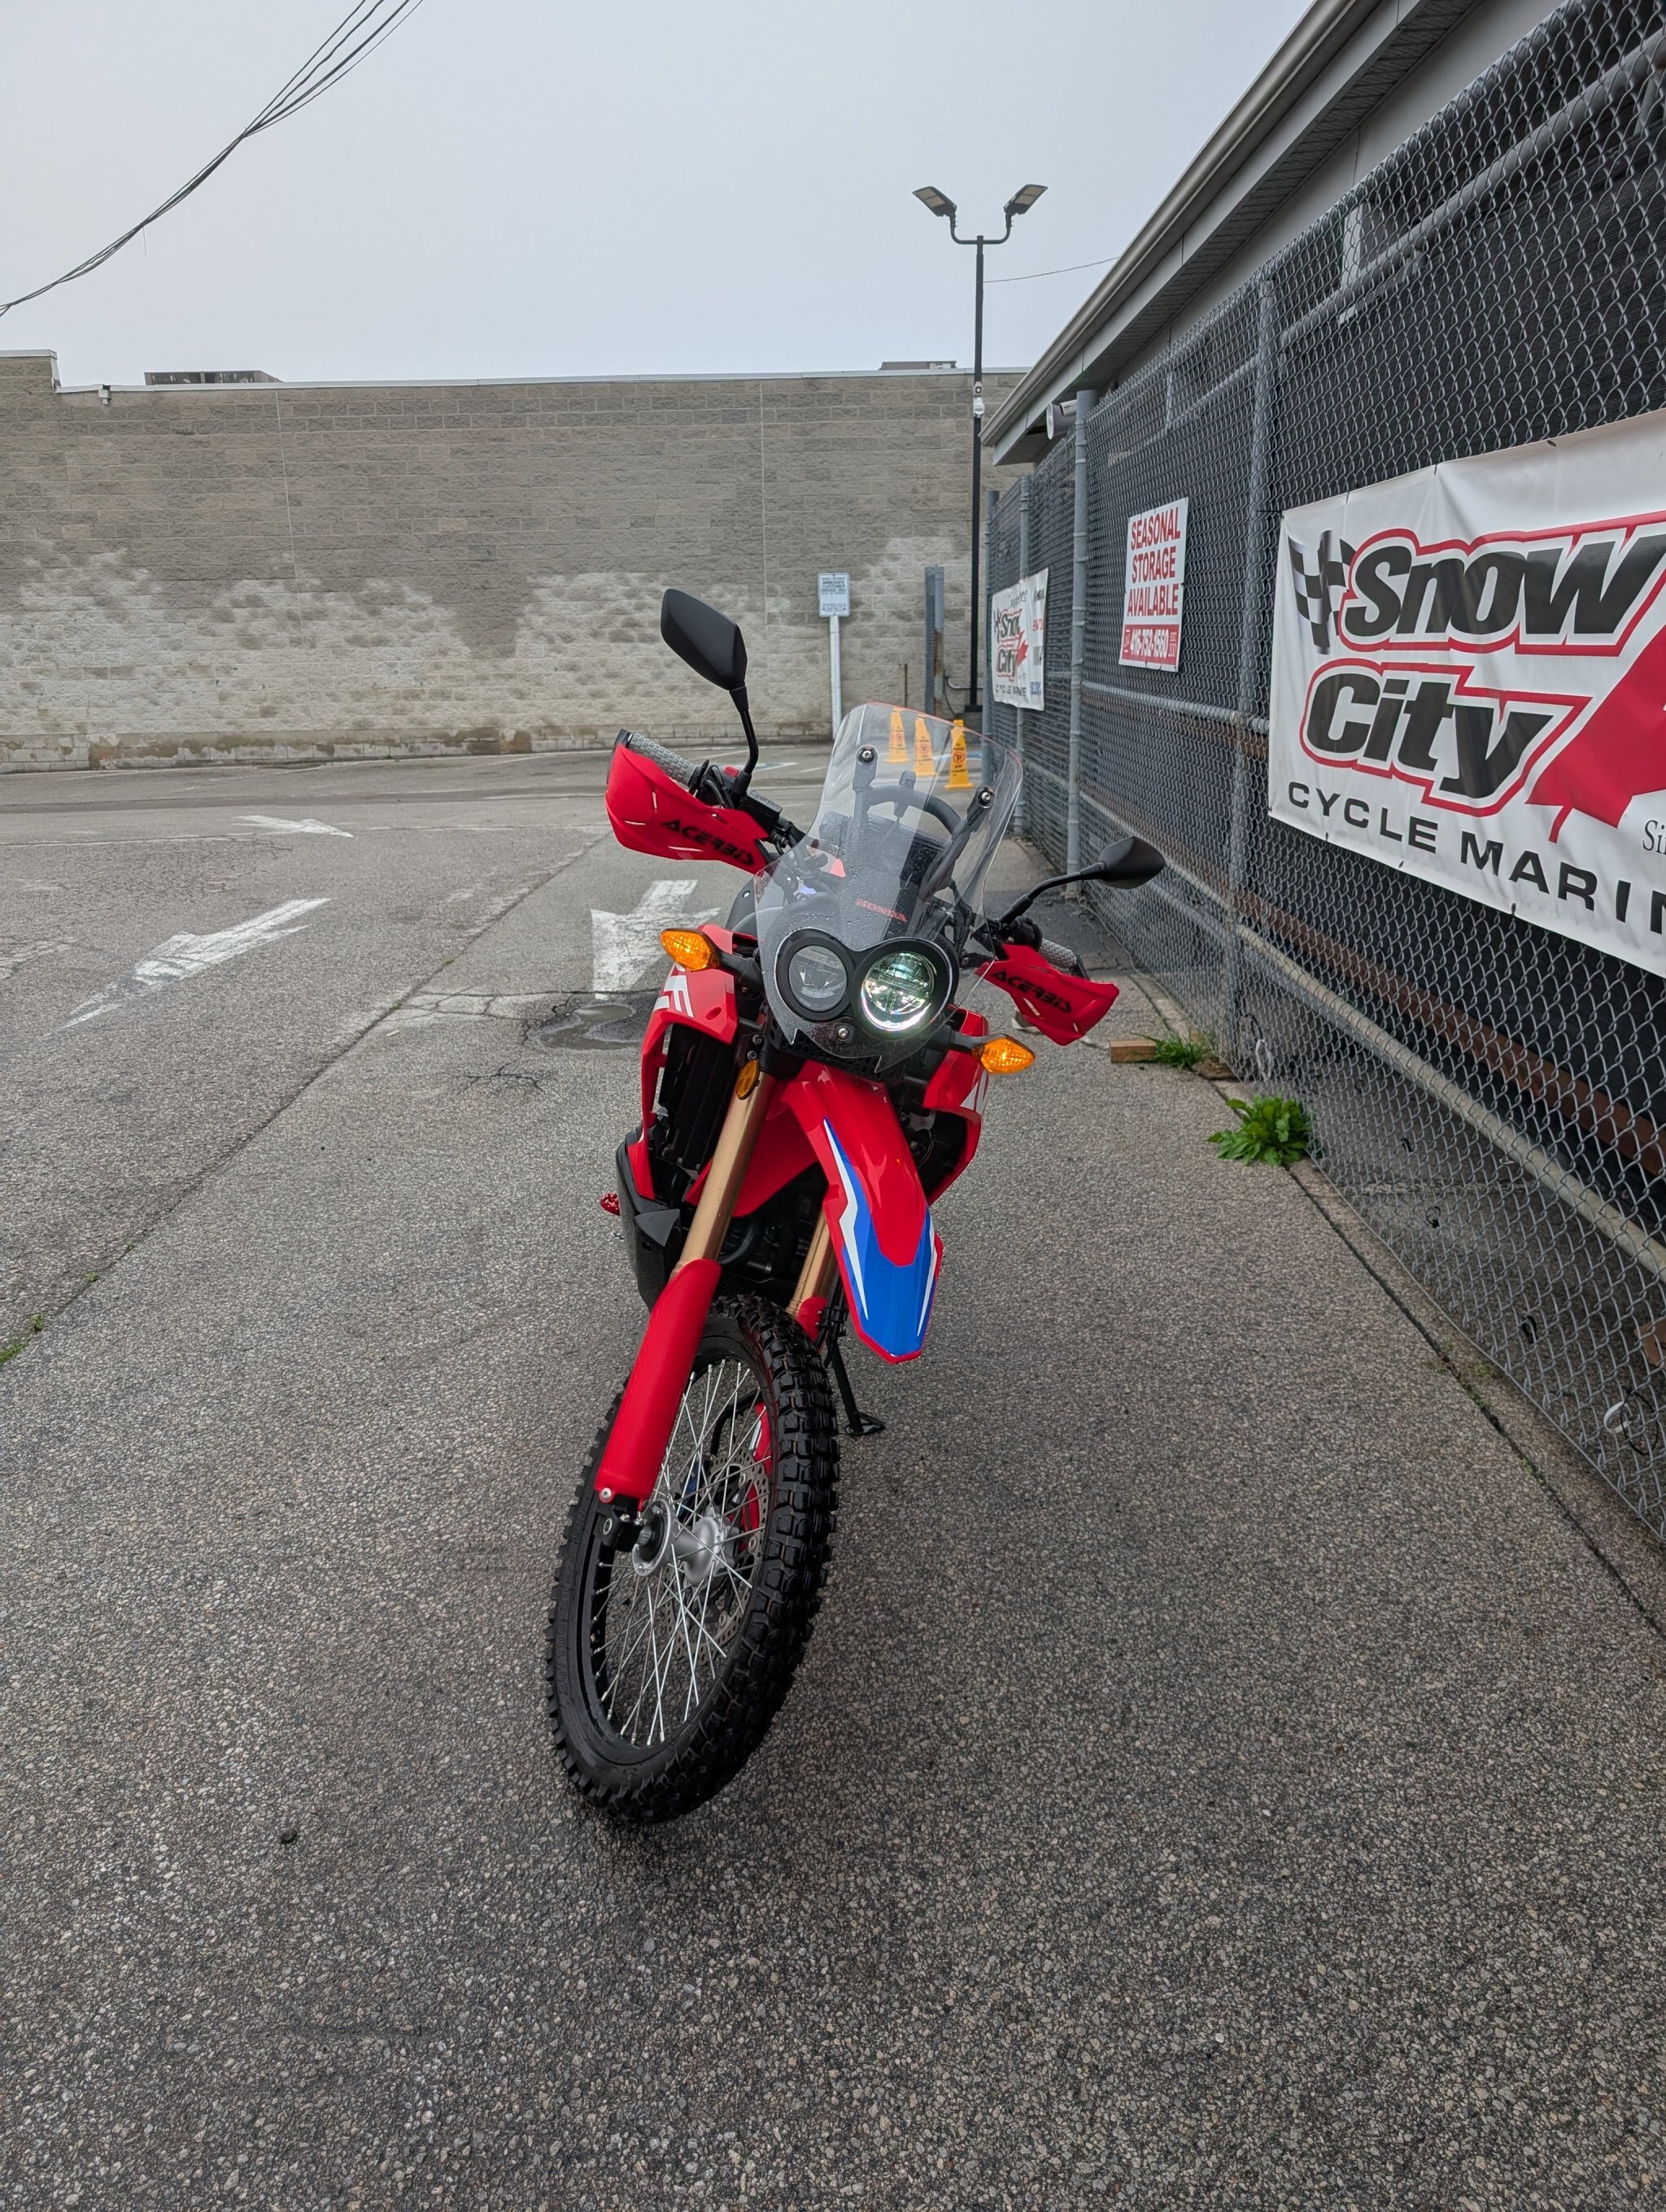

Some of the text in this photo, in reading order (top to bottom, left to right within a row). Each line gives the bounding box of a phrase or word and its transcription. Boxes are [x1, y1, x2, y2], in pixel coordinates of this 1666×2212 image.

[1131, 507, 1181, 551] SEASONAL
[1132, 546, 1176, 584] STORAGE
[1344, 532, 1666, 637] Snow
[1127, 583, 1179, 617] AVAILABLE
[997, 649, 1017, 677] City
[1305, 672, 1555, 799] City
[1289, 782, 1438, 854] CYCLE
[1642, 819, 1666, 855] Si
[662, 819, 754, 865] ACERBIS
[855, 898, 908, 923] HONDA
[991, 969, 1072, 1012] ACERBIS
